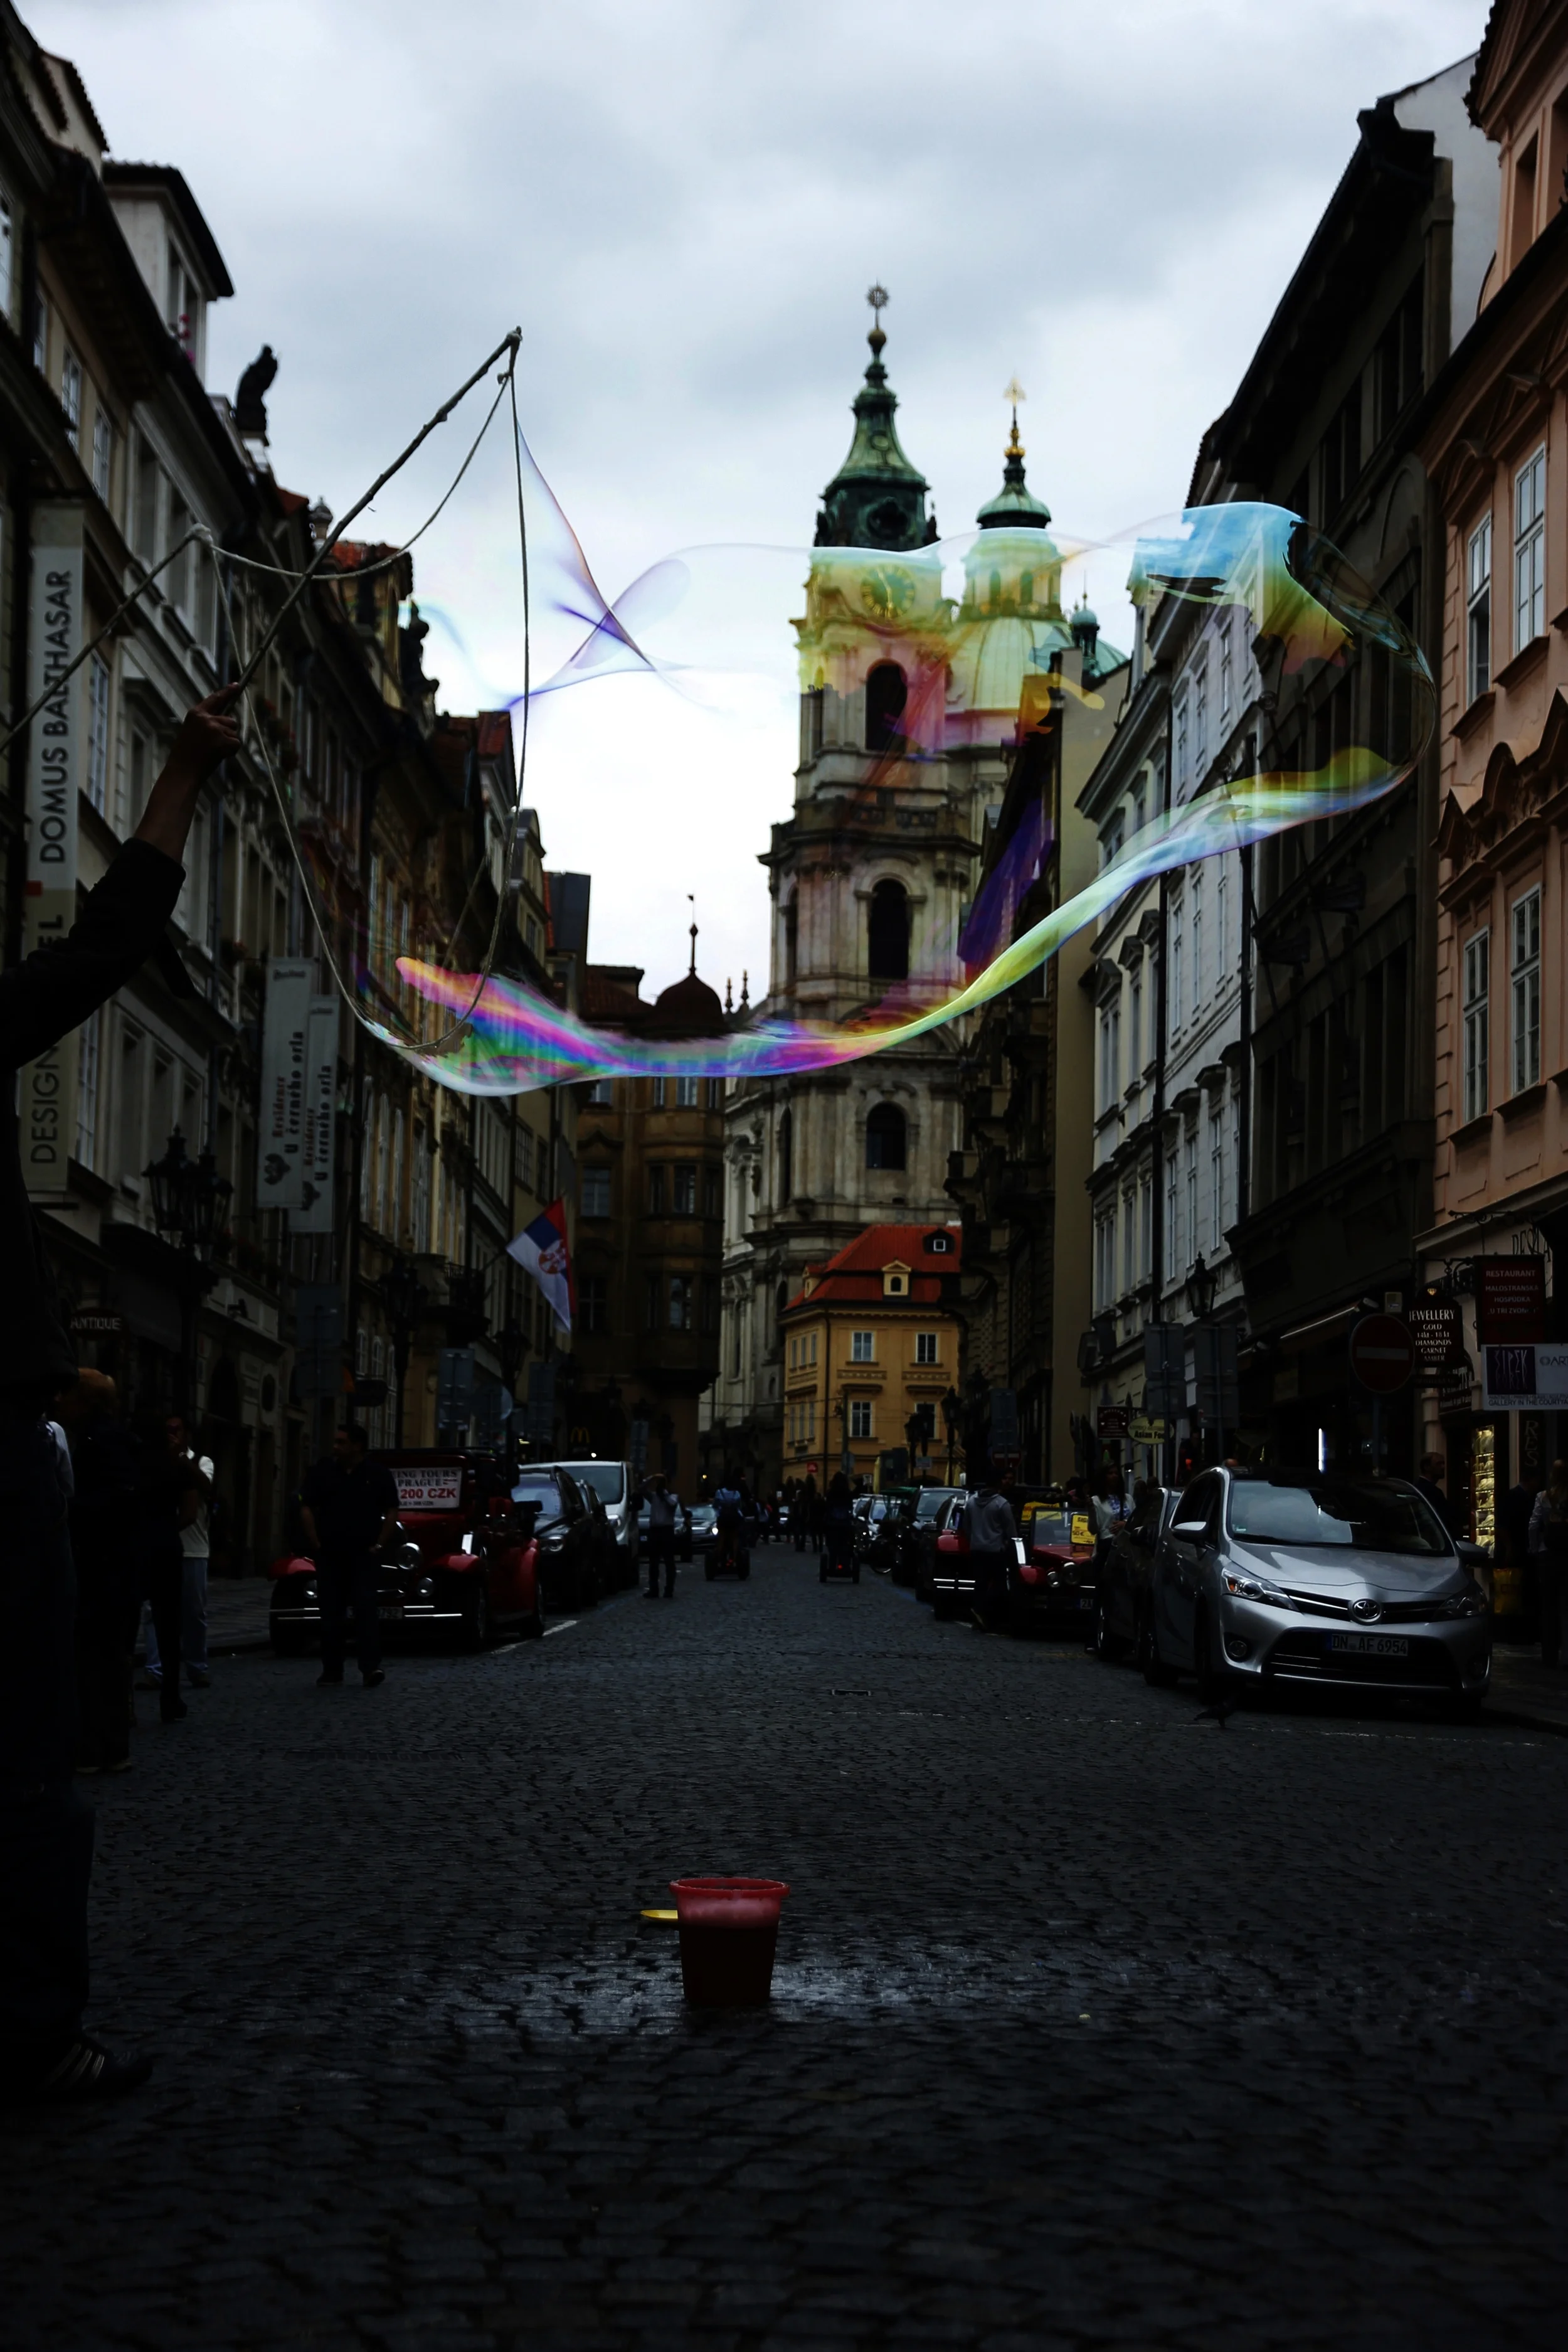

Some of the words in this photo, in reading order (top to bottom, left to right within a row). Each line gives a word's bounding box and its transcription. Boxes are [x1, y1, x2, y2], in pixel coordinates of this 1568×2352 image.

[43, 570, 72, 737] BALTHASAR
[40, 746, 69, 864] DOMUS
[30, 1045, 60, 1164] DESIGN
[1485, 1269, 1536, 1278] RESTAURANT
[1409, 1308, 1456, 1323] JEWELLERY
[70, 1316, 122, 1331] ANTIQUE
[421, 1469, 457, 1478] TOURS
[398, 1479, 442, 1487] PRAGUE
[427, 1487, 457, 1499] CZK
[1332, 1635, 1348, 1649] DN
[1358, 1637, 1374, 1651] AF
[1377, 1639, 1406, 1654] 6954
